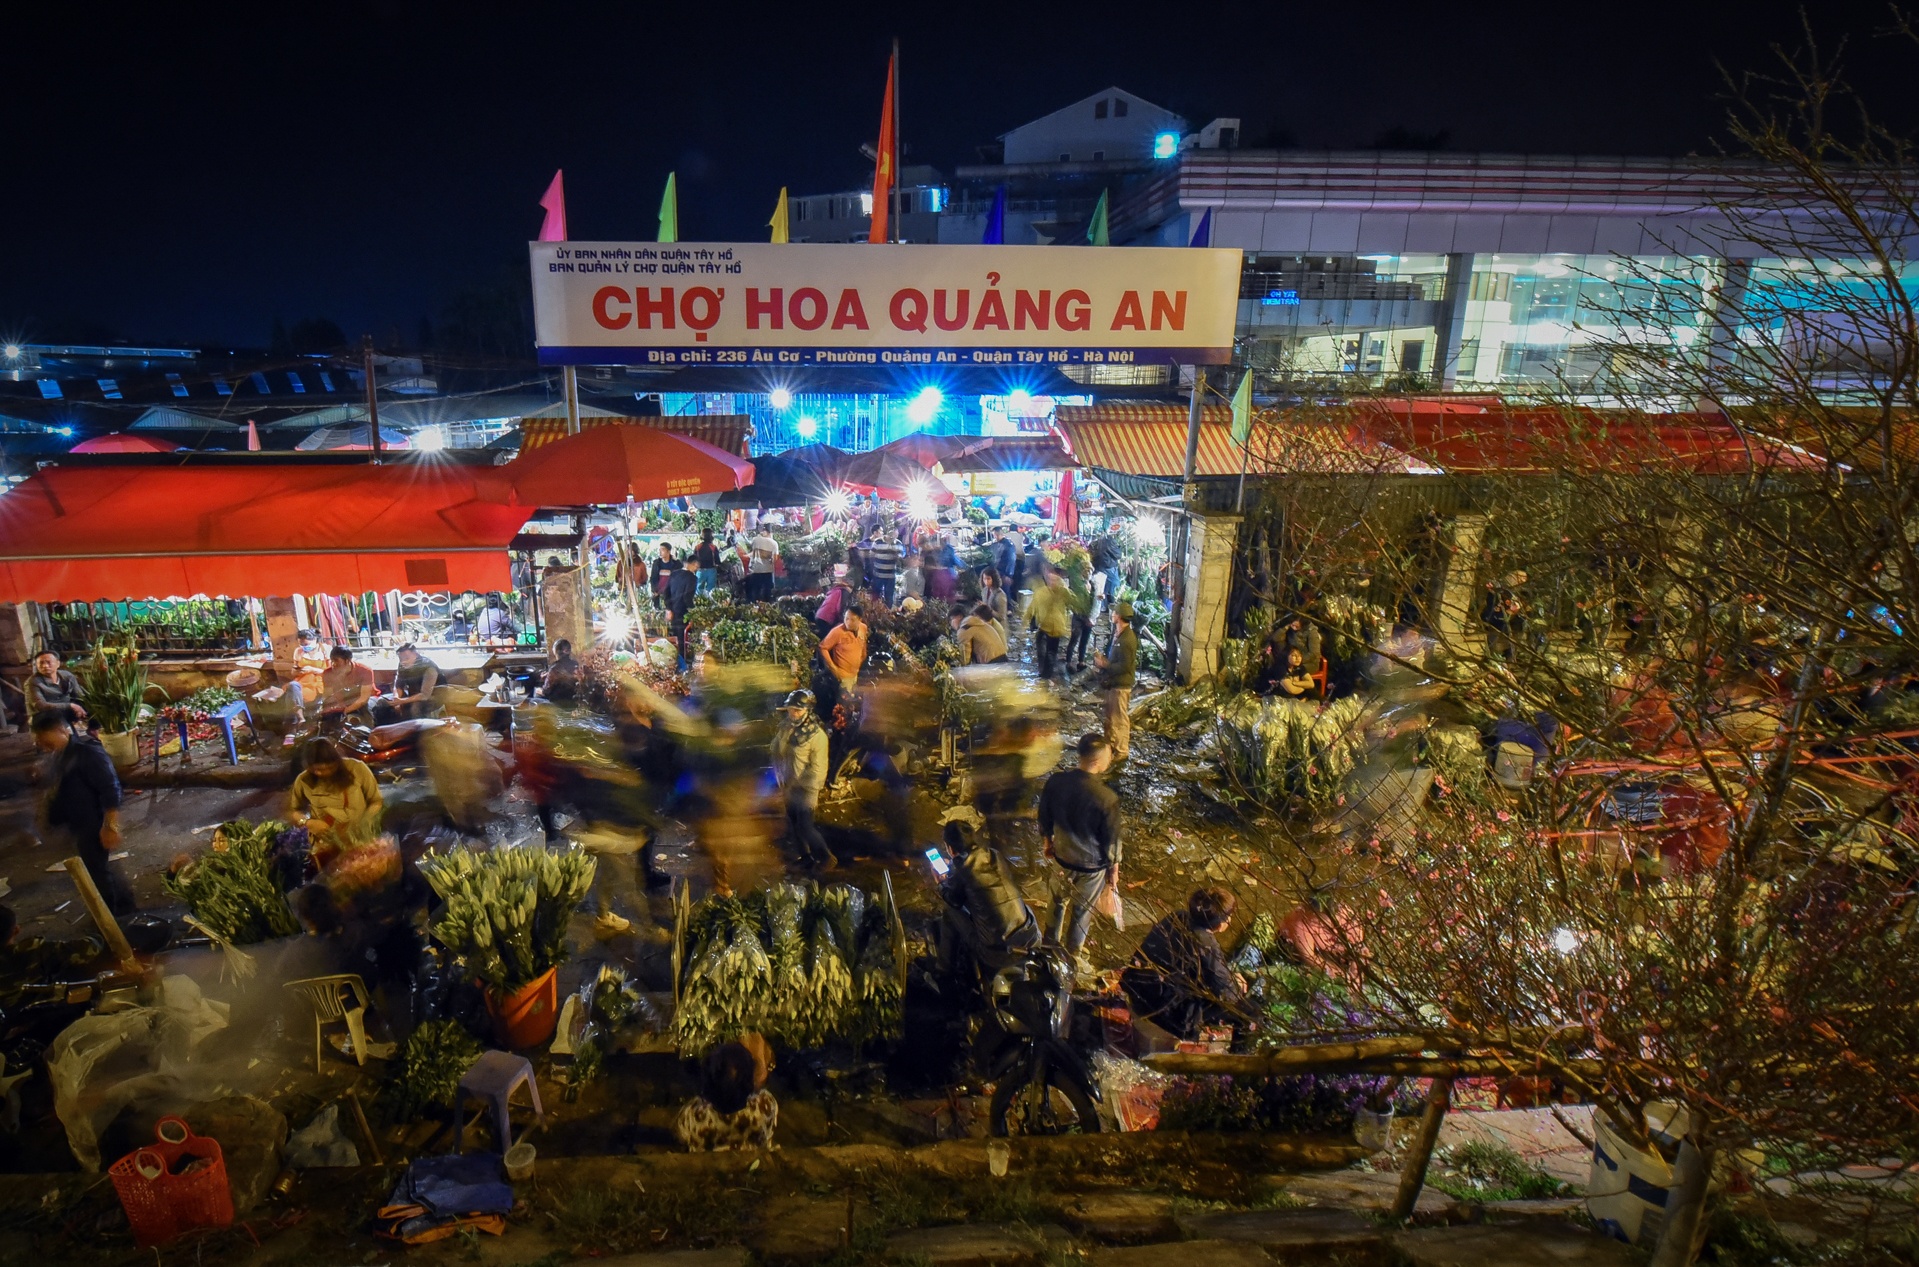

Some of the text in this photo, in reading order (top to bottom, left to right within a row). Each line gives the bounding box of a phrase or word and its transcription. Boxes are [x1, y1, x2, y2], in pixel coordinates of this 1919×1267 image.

[556, 247, 733, 262] ỦY BAN NHÂN DÂN QUẬN TÂY HỒ
[549, 260, 742, 276] BAN QUẢN LÝ CHỢ QUẬN TÂY HỒ
[592, 271, 1188, 342] CHỢ HOA QUẢNG AN
[648, 350, 676, 364] Địa
[680, 349, 712, 362] chỉ:
[716, 351, 747, 362] 236
[752, 349, 774, 362] Âu
[778, 351, 800, 362] Cơ
[816, 350, 877, 363] Phường
[881, 349, 932, 363] Quảng
[936, 351, 957, 362] An
[972, 350, 1013, 364] Quận
[1016, 350, 1044, 363] Tây
[1047, 349, 1069, 362] Hồ
[1083, 350, 1104, 362] Hà
[1107, 350, 1134, 363] Nội
